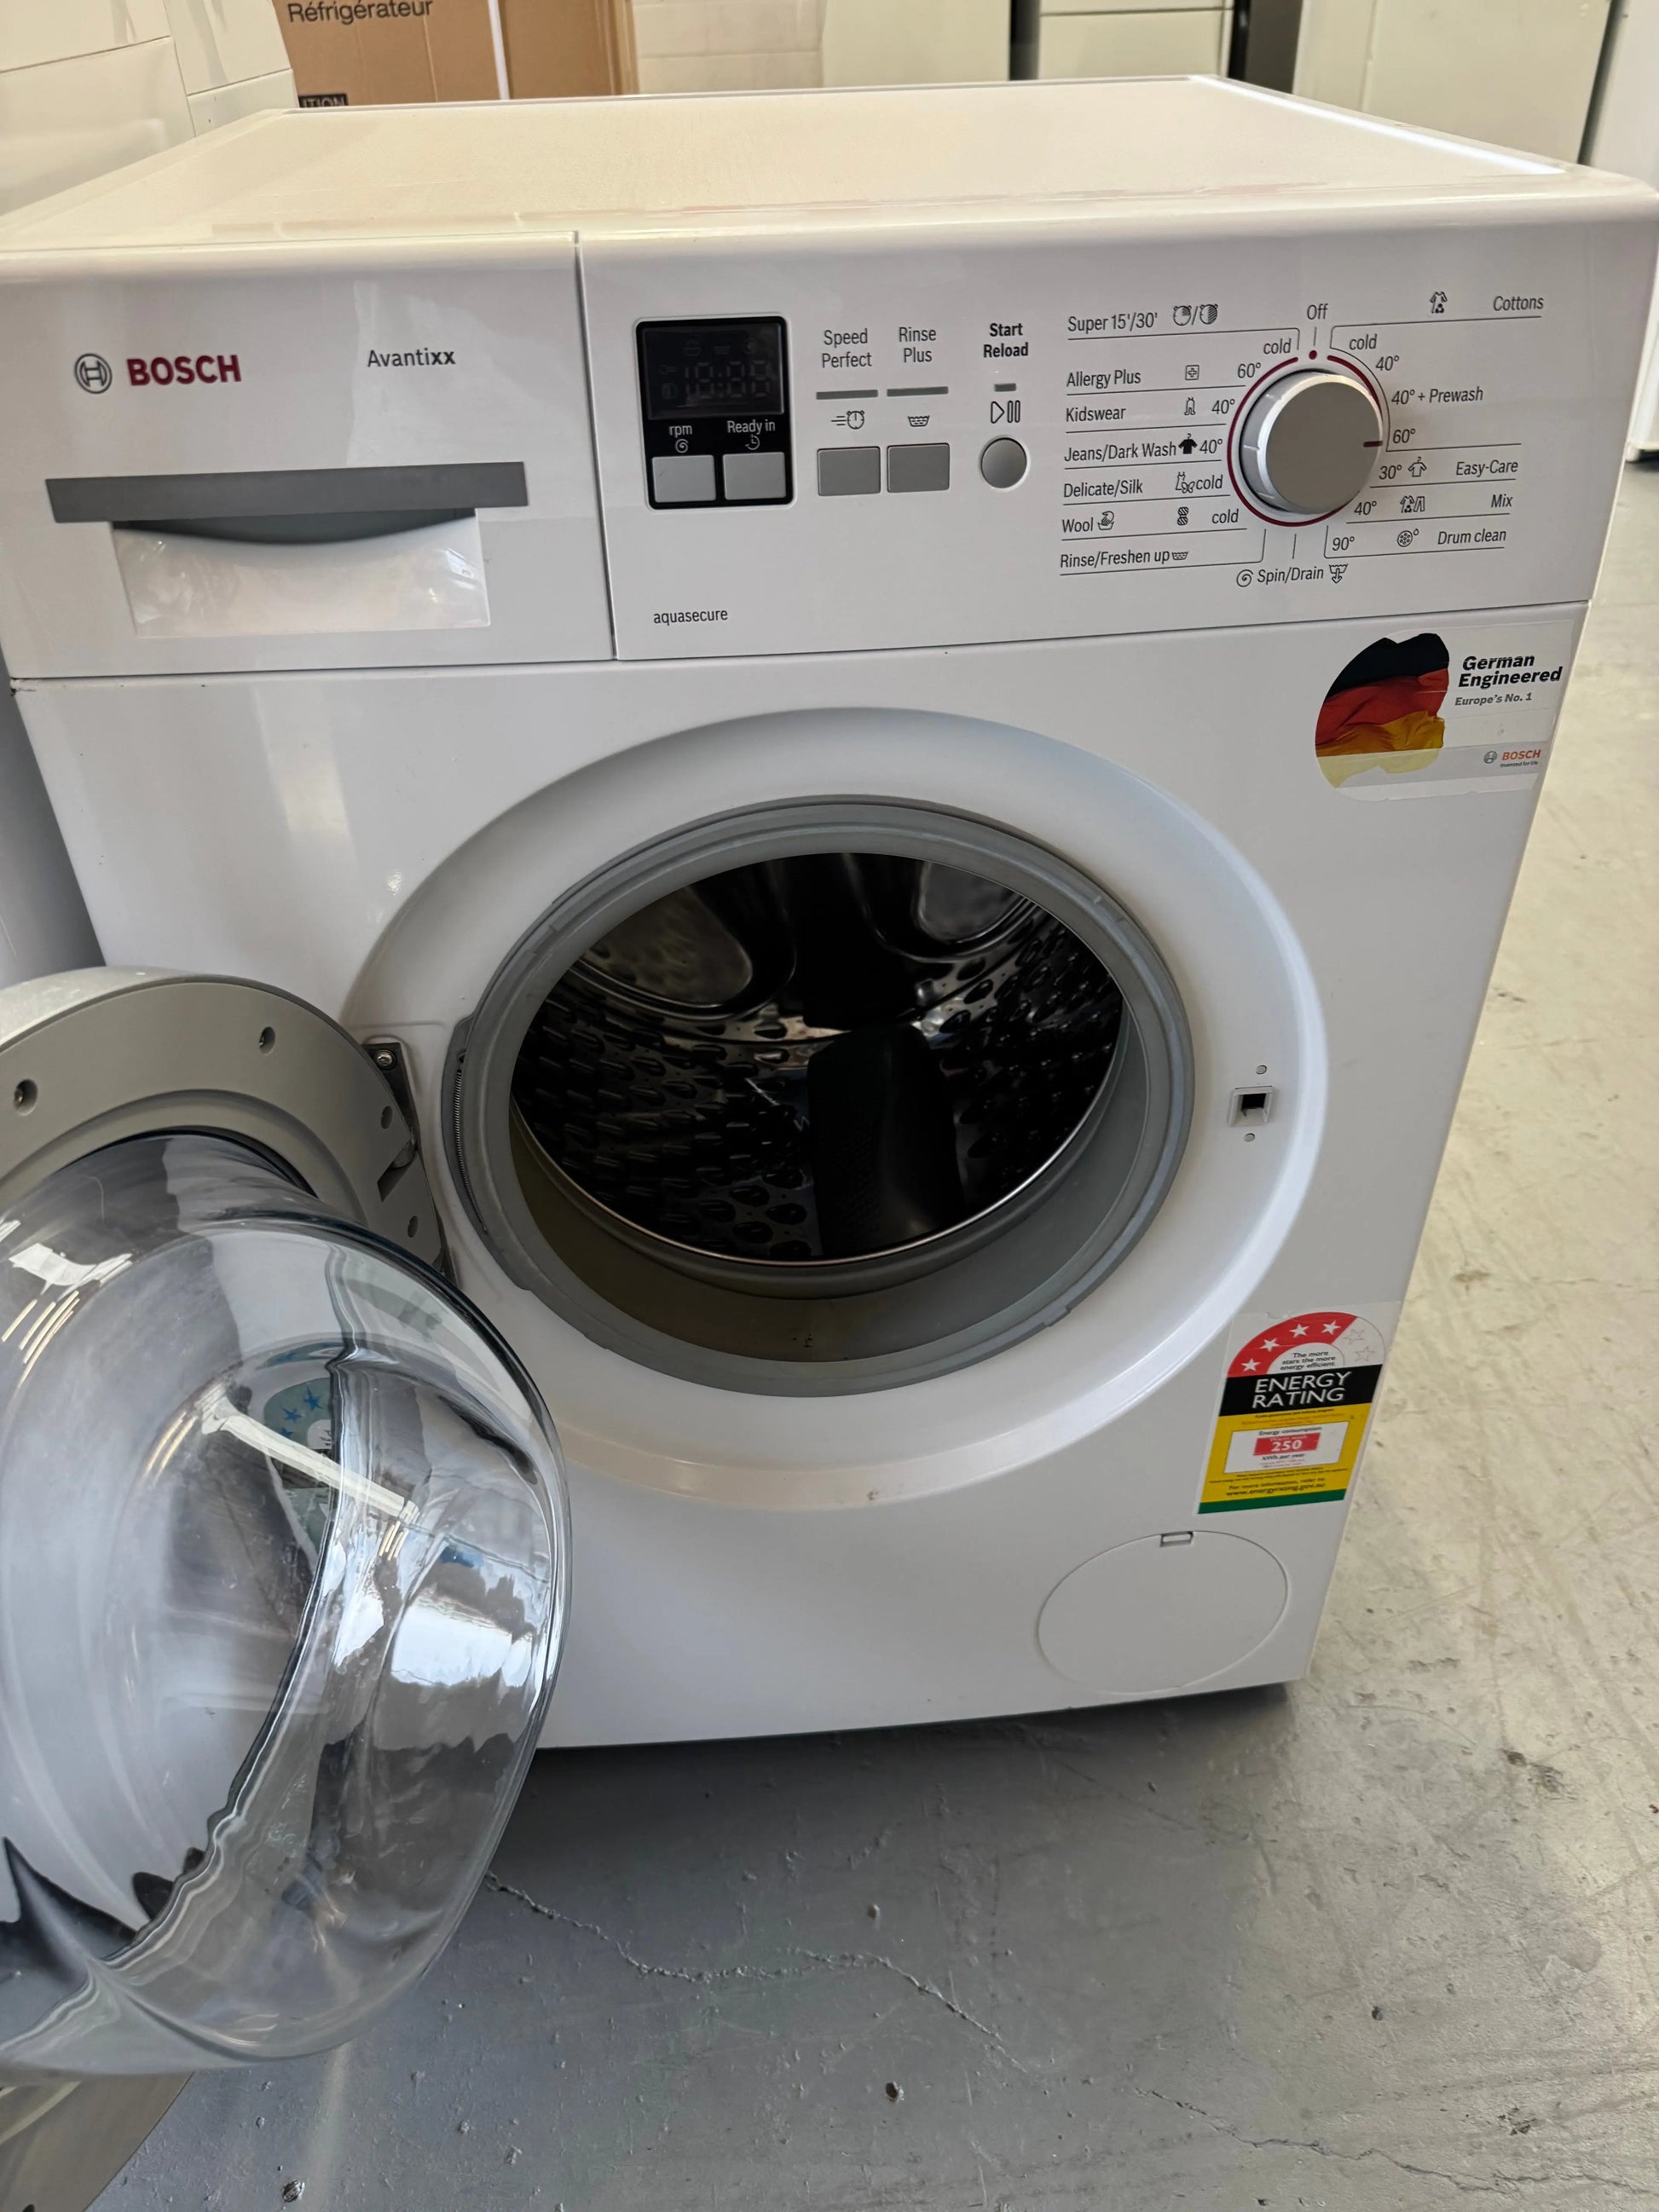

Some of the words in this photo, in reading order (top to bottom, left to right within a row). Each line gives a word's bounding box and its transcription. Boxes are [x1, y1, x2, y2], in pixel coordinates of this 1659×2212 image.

[287, 0, 432, 26] Réfrigérateur
[1306, 303, 1328, 321] Off
[1493, 296, 1544, 312] Cottons
[899, 326, 937, 343] Rinse
[990, 322, 1023, 338] Start
[1067, 316, 1108, 334] Super
[824, 327, 869, 349] Speed
[1263, 338, 1292, 355] cold
[1349, 333, 1377, 350] cold
[367, 347, 456, 368] Avantixx
[821, 351, 872, 370] Perfect
[904, 347, 933, 364] Plus
[983, 343, 1029, 359] Reload
[126, 355, 242, 386] BOSCH
[1376, 355, 1400, 371] 40°
[1066, 369, 1110, 389] Allergy
[1114, 369, 1142, 384] Plus
[1237, 362, 1262, 379] 60°
[1391, 390, 1415, 405] 40°
[1429, 385, 1483, 402] Prewash
[1066, 405, 1126, 423] Kidswear
[1212, 399, 1235, 415] 40°
[669, 425, 692, 438] rpm
[726, 419, 762, 435] Ready
[765, 419, 776, 431] in
[1392, 428, 1416, 444] 60°
[1064, 444, 1138, 463] Jeans/Dark
[1142, 442, 1176, 458] Wash
[1199, 439, 1223, 454] 40°
[1379, 465, 1402, 480] 30°
[1455, 460, 1518, 476] Easy-Care
[1064, 479, 1143, 499] Delicate/Silk
[1196, 475, 1223, 491] cold
[1354, 500, 1377, 516] 40°
[1491, 494, 1513, 509] Mix
[1062, 517, 1094, 533] Wool
[1211, 508, 1240, 524] cold
[1332, 536, 1355, 552] 90°
[1437, 531, 1471, 546] Drum
[1474, 529, 1507, 543] clean
[1061, 551, 1151, 569] Rinse/Freshen
[1153, 550, 1171, 564] up
[1257, 566, 1324, 585] Spin/Drain
[653, 608, 728, 625] aquasecure
[1462, 655, 1535, 671] German
[1458, 667, 1563, 690] Engineered
[1454, 693, 1503, 706] Europe's
[1505, 694, 1523, 702] No.
[1526, 692, 1532, 701] 1
[1502, 749, 1541, 760] BOSCH
[1255, 1371, 1352, 1394] ENERGY
[1251, 1388, 1346, 1409] RATING
[1270, 1439, 1303, 1452] 250
